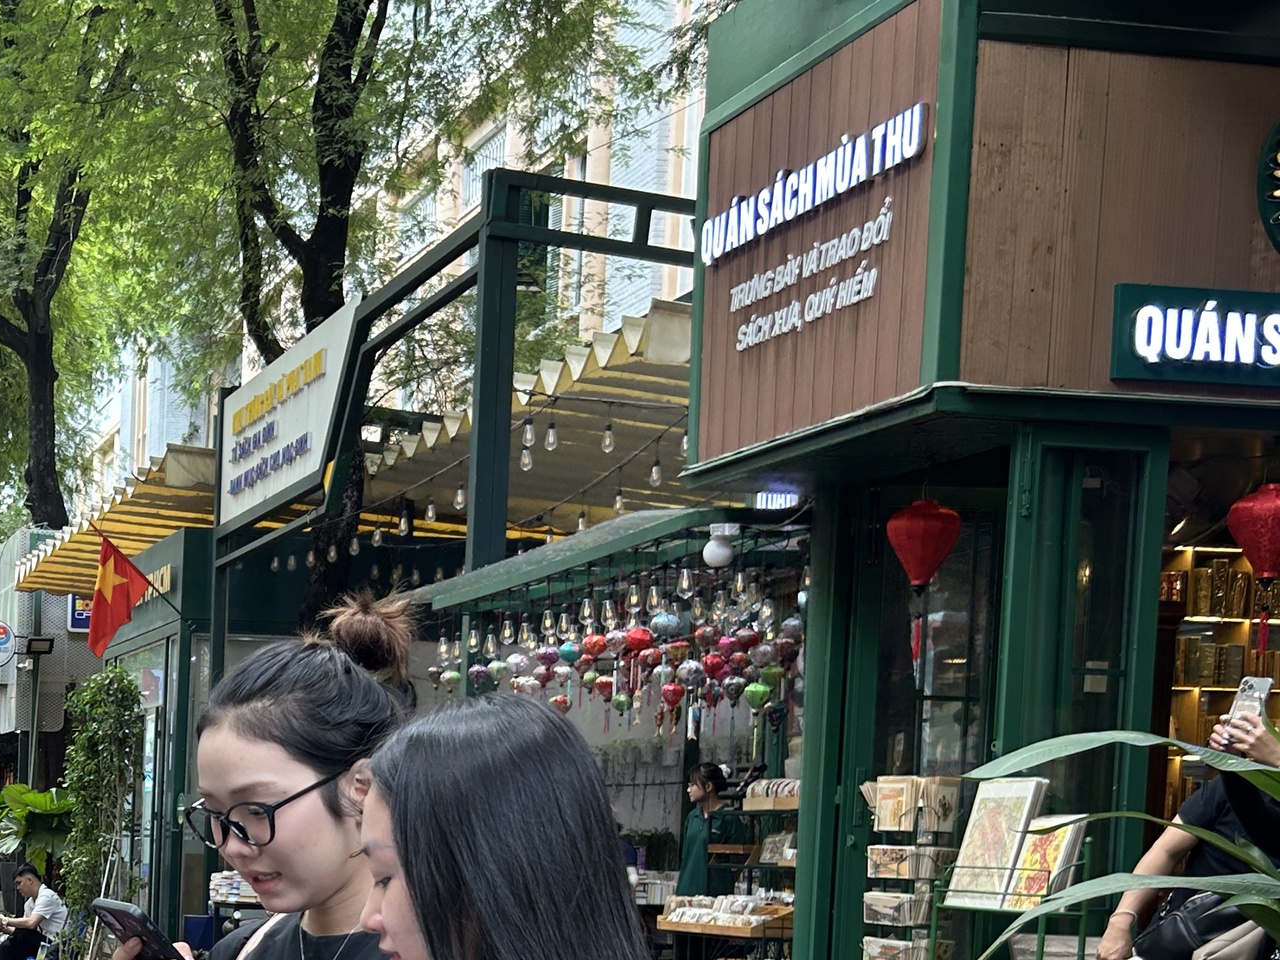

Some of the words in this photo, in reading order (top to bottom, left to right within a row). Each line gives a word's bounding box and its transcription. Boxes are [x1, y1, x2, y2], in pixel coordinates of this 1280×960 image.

[701, 195, 756, 266] QUÁN
[756, 166, 816, 235] SÁCH
[871, 101, 923, 176] THU
[819, 226, 863, 271] TRAO
[736, 313, 772, 352] SÁCH
[1134, 299, 1258, 364] QUÁN
